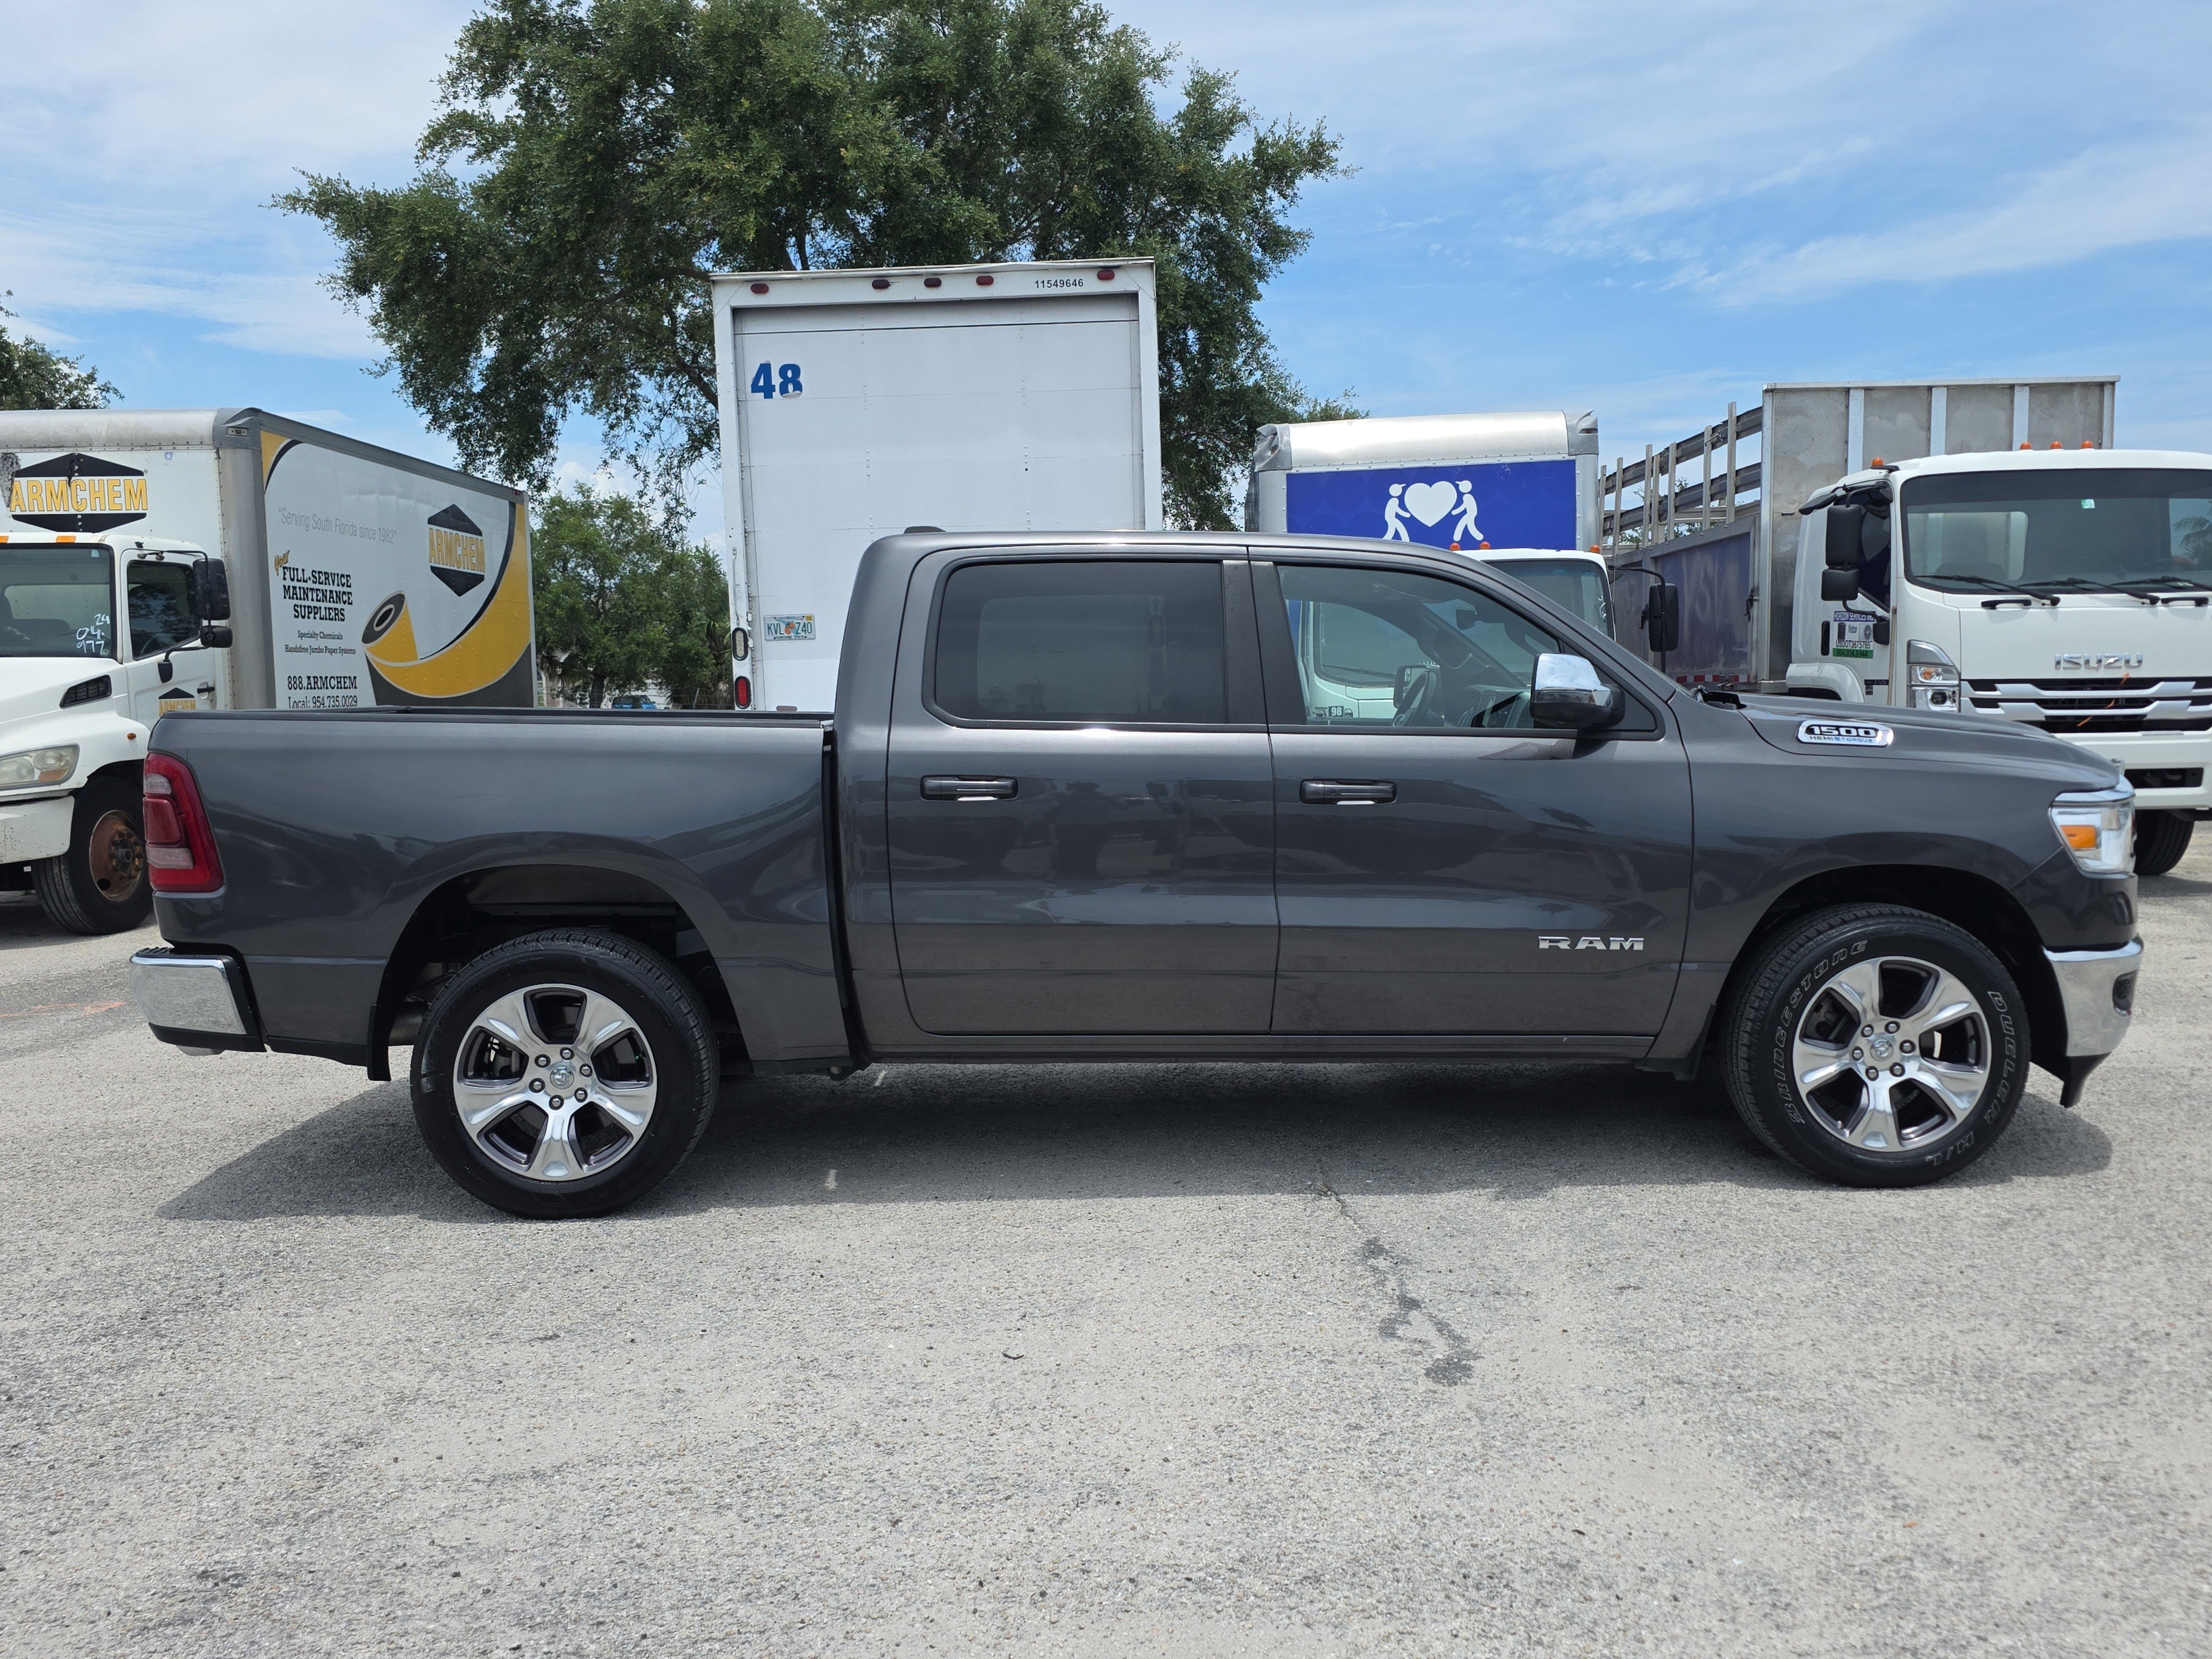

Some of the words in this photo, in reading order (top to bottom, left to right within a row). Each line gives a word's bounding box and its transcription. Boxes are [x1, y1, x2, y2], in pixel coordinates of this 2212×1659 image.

[1034, 279, 1084, 288] 11549646
[751, 363, 802, 398] 48
[10, 479, 148, 512] ARMCHEM
[312, 513, 332, 532] South
[335, 518, 357, 537] Florida
[359, 524, 376, 541] since
[429, 528, 485, 573] ARMCHEM
[283, 584, 353, 605] MAINTENANCE
[94, 614, 111, 626] 24
[293, 604, 345, 622] SUPPLIERS
[767, 623, 785, 635] KVL
[795, 621, 813, 634] Z40
[298, 630, 319, 641] Specialty
[319, 631, 343, 640] Chemicals
[76, 640, 105, 655] 977
[309, 645, 324, 655] Jumbo
[325, 646, 338, 655] Paper
[338, 646, 356, 656] Systems
[2055, 653, 2143, 671] ISUZU
[287, 676, 357, 690] 888.ARMCHEM
[312, 695, 358, 709] 954.735.0029
[1331, 707, 1343, 716] 98
[1810, 726, 1877, 737] 1500
[1538, 936, 1644, 950] RAM
[1773, 940, 1868, 1124] BRIDGESTONE
[1984, 991, 2016, 1124] DUELER
